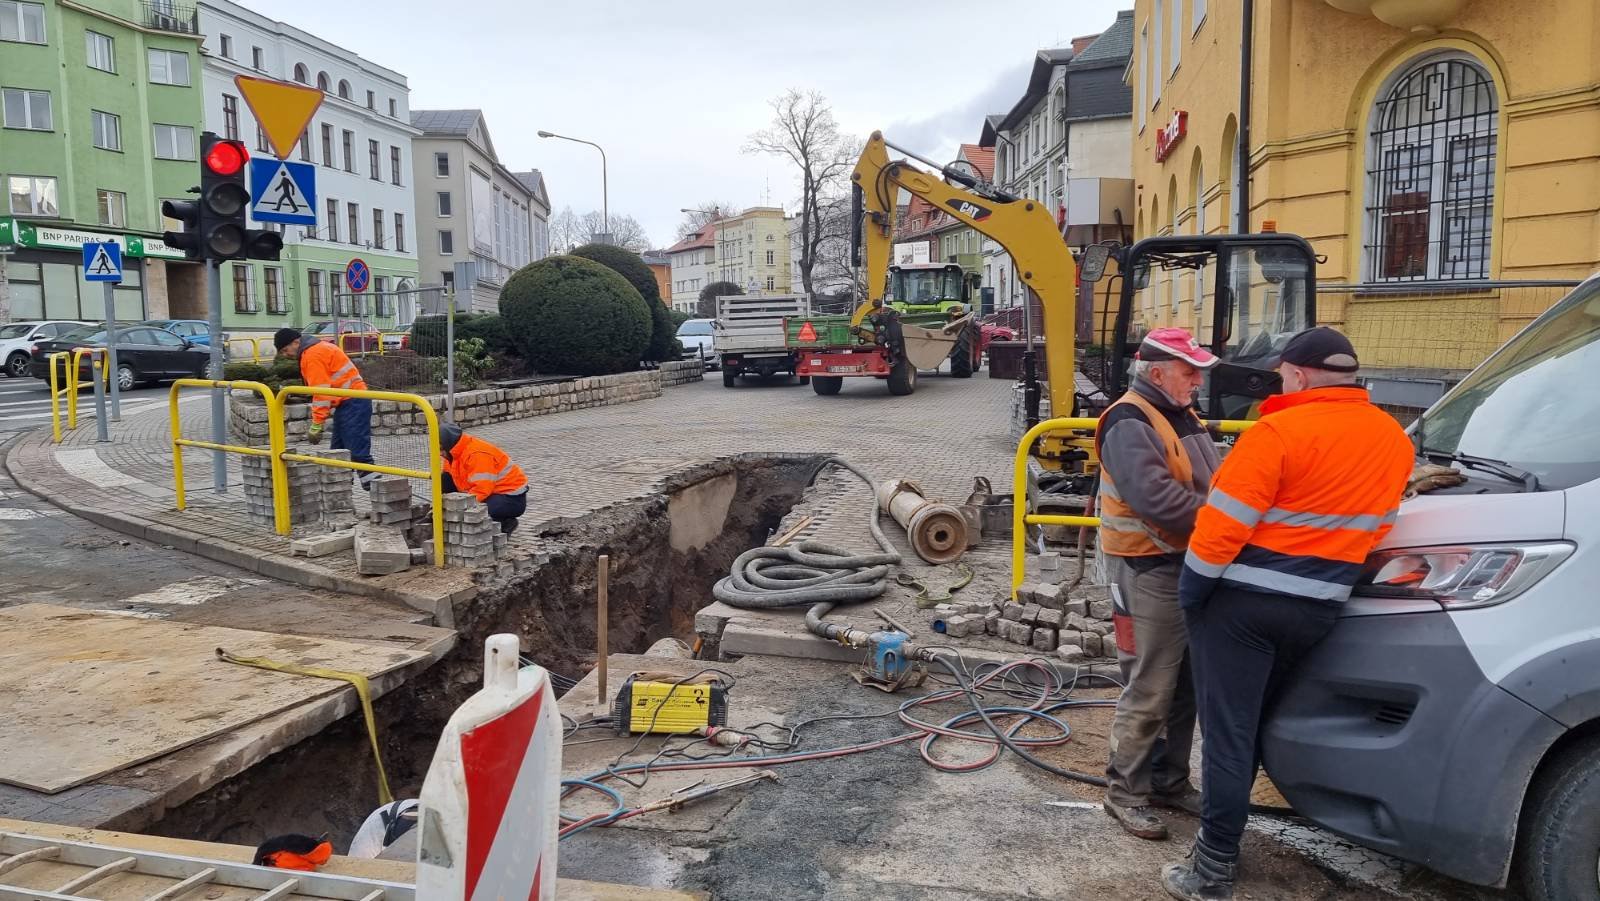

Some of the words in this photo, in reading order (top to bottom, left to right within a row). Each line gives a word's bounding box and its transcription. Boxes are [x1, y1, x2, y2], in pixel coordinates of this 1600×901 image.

[960, 202, 980, 219] CAT
[43, 232, 62, 241] BNP
[148, 243, 164, 251] BNP
